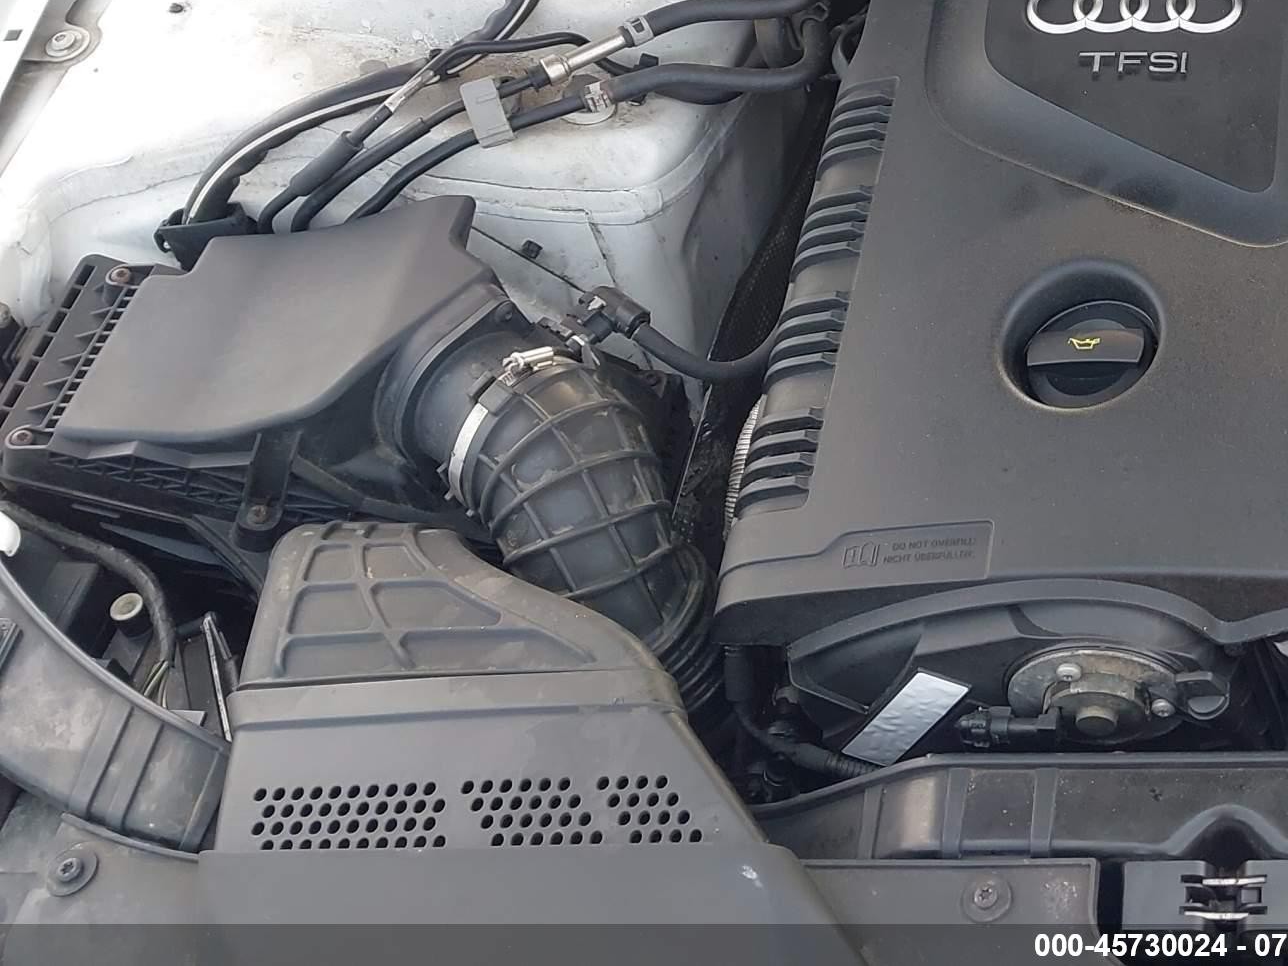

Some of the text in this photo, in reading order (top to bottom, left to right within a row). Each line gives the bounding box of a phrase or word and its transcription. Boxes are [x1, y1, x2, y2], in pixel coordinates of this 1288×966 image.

[1079, 52, 1188, 73] TFSI
[892, 542, 906, 551] DO
[909, 540, 930, 550] NOT
[883, 553, 911, 564] NICHT
